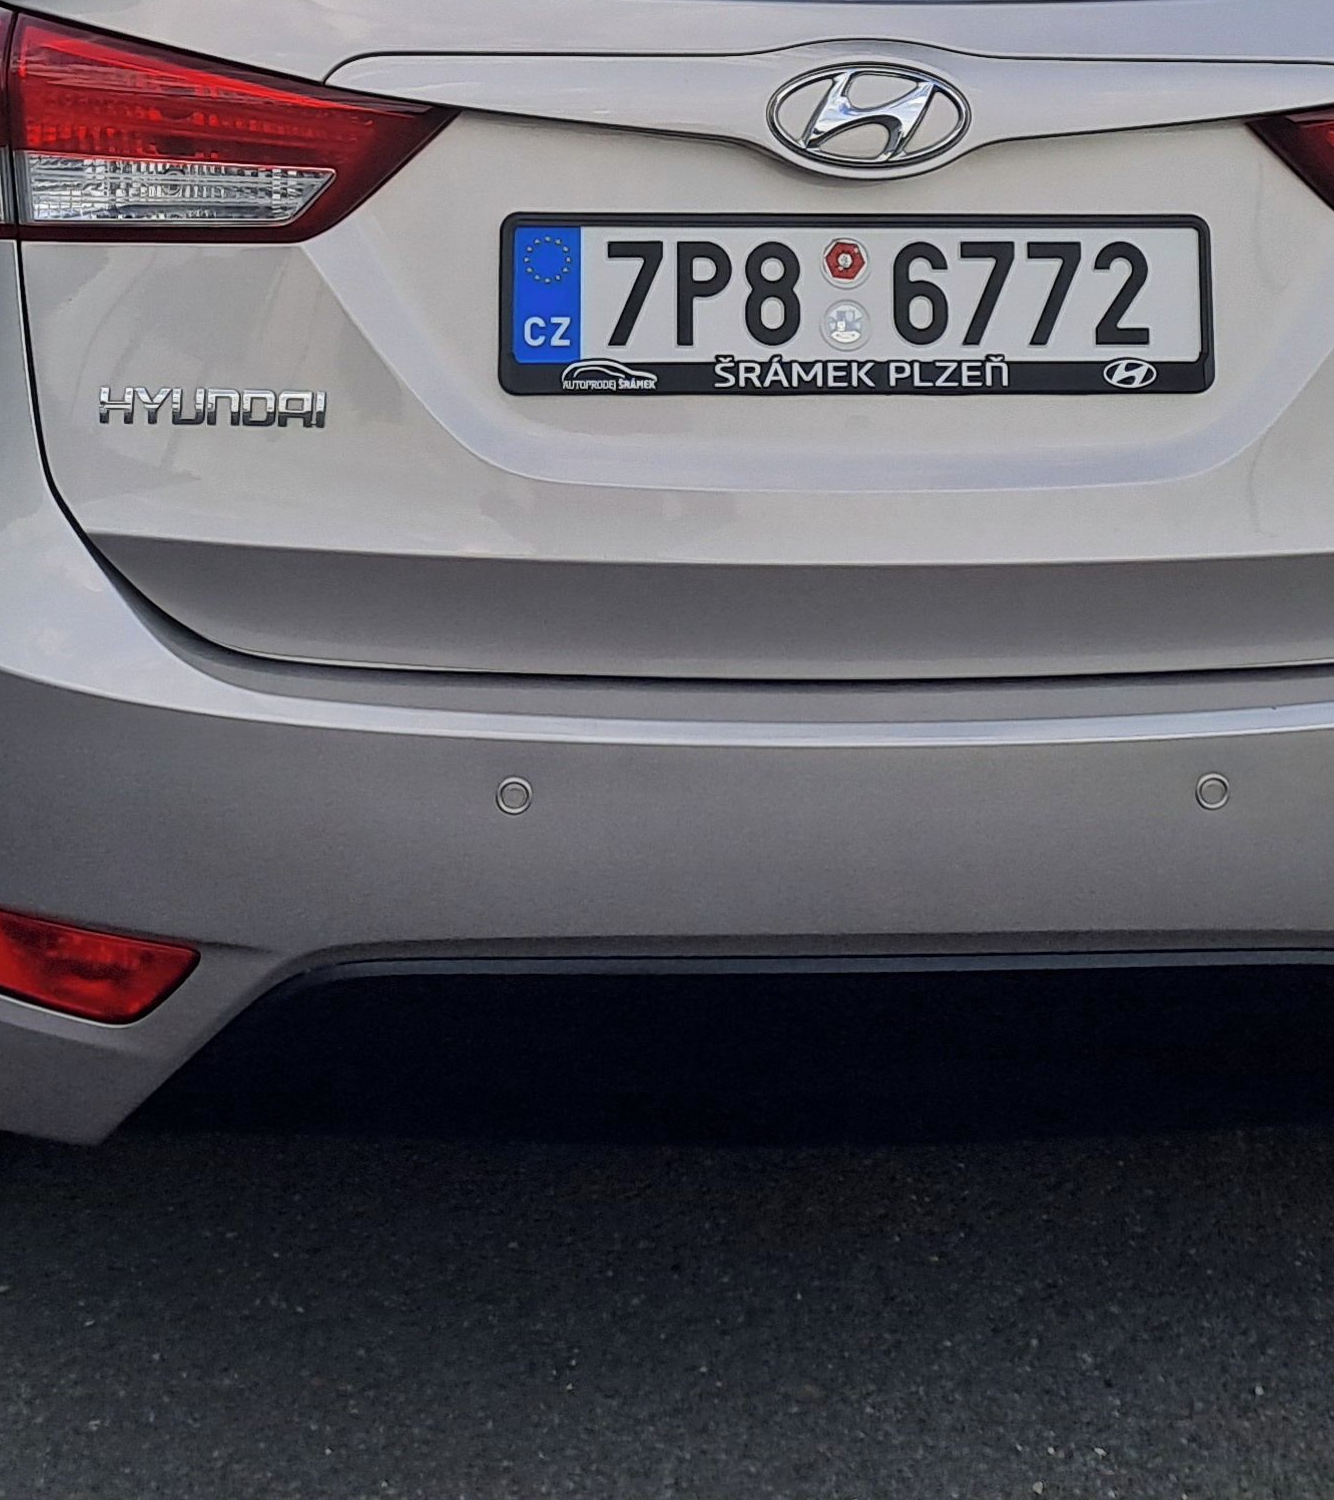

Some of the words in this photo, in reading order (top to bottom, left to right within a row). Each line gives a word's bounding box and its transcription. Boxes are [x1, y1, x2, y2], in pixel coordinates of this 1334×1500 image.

[606, 240, 802, 347] 7P8
[891, 241, 1151, 346] 6772
[523, 317, 571, 347] CZ
[562, 379, 616, 391] AUTOPRODEJ
[714, 357, 876, 389] ŠRÁMEK
[98, 386, 328, 429] HYUNDAI
